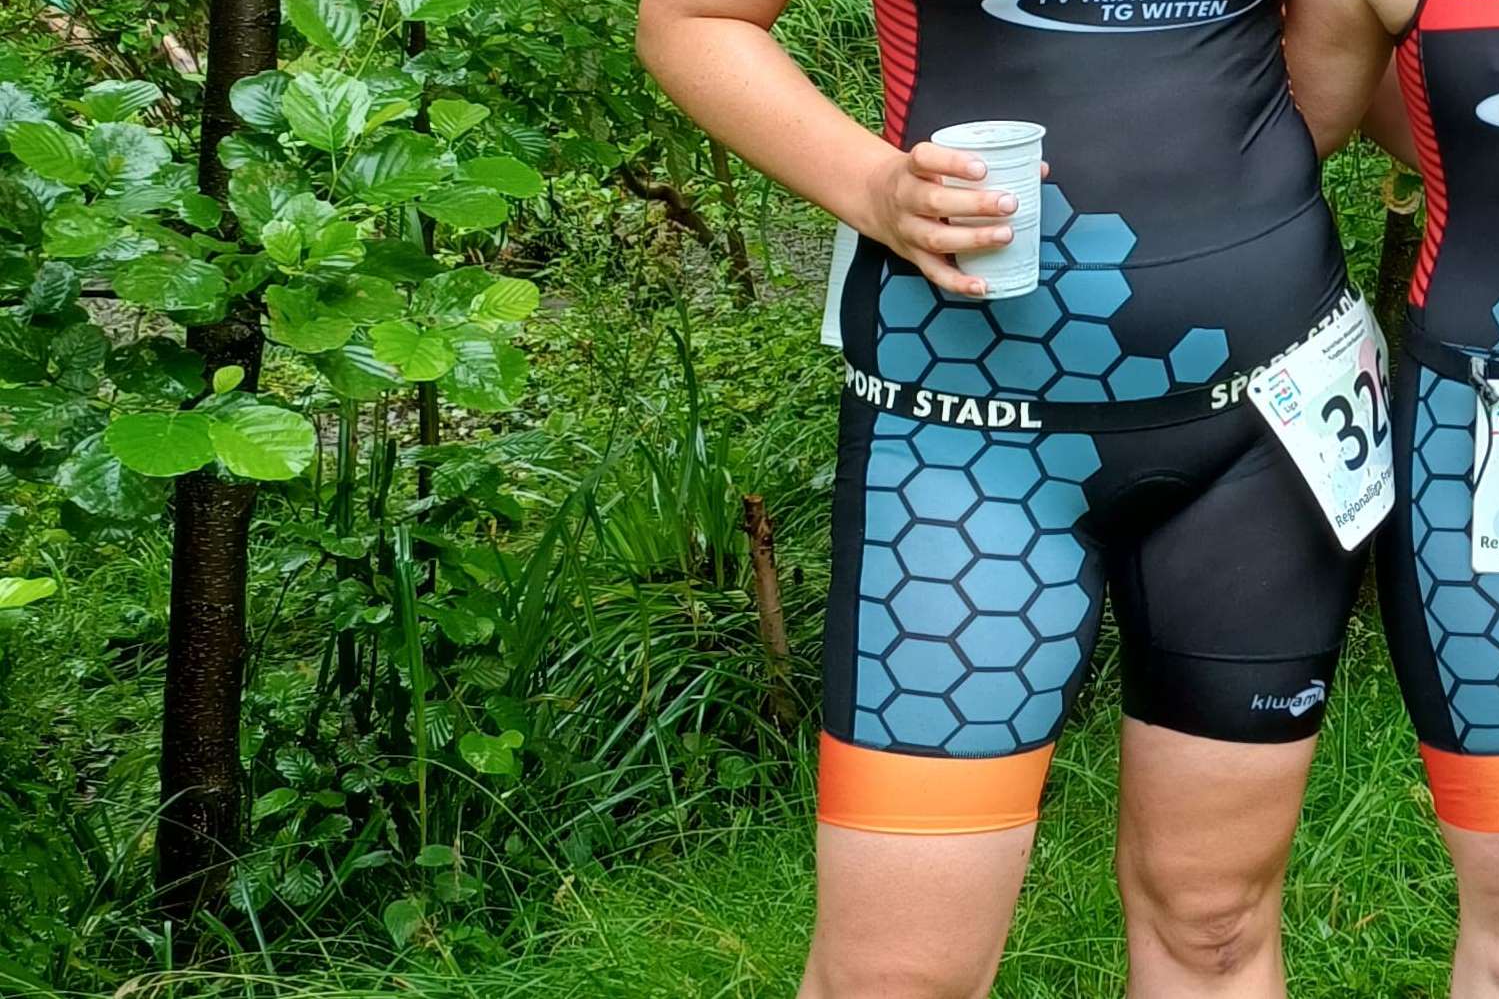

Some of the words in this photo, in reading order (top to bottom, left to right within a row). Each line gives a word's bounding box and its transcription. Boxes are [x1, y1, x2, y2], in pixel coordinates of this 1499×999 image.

[1100, 3, 1135, 22] TG
[1140, 0, 1228, 21] WITTEN
[913, 390, 1043, 429] STADL
[1335, 479, 1382, 528] Regionalliga
